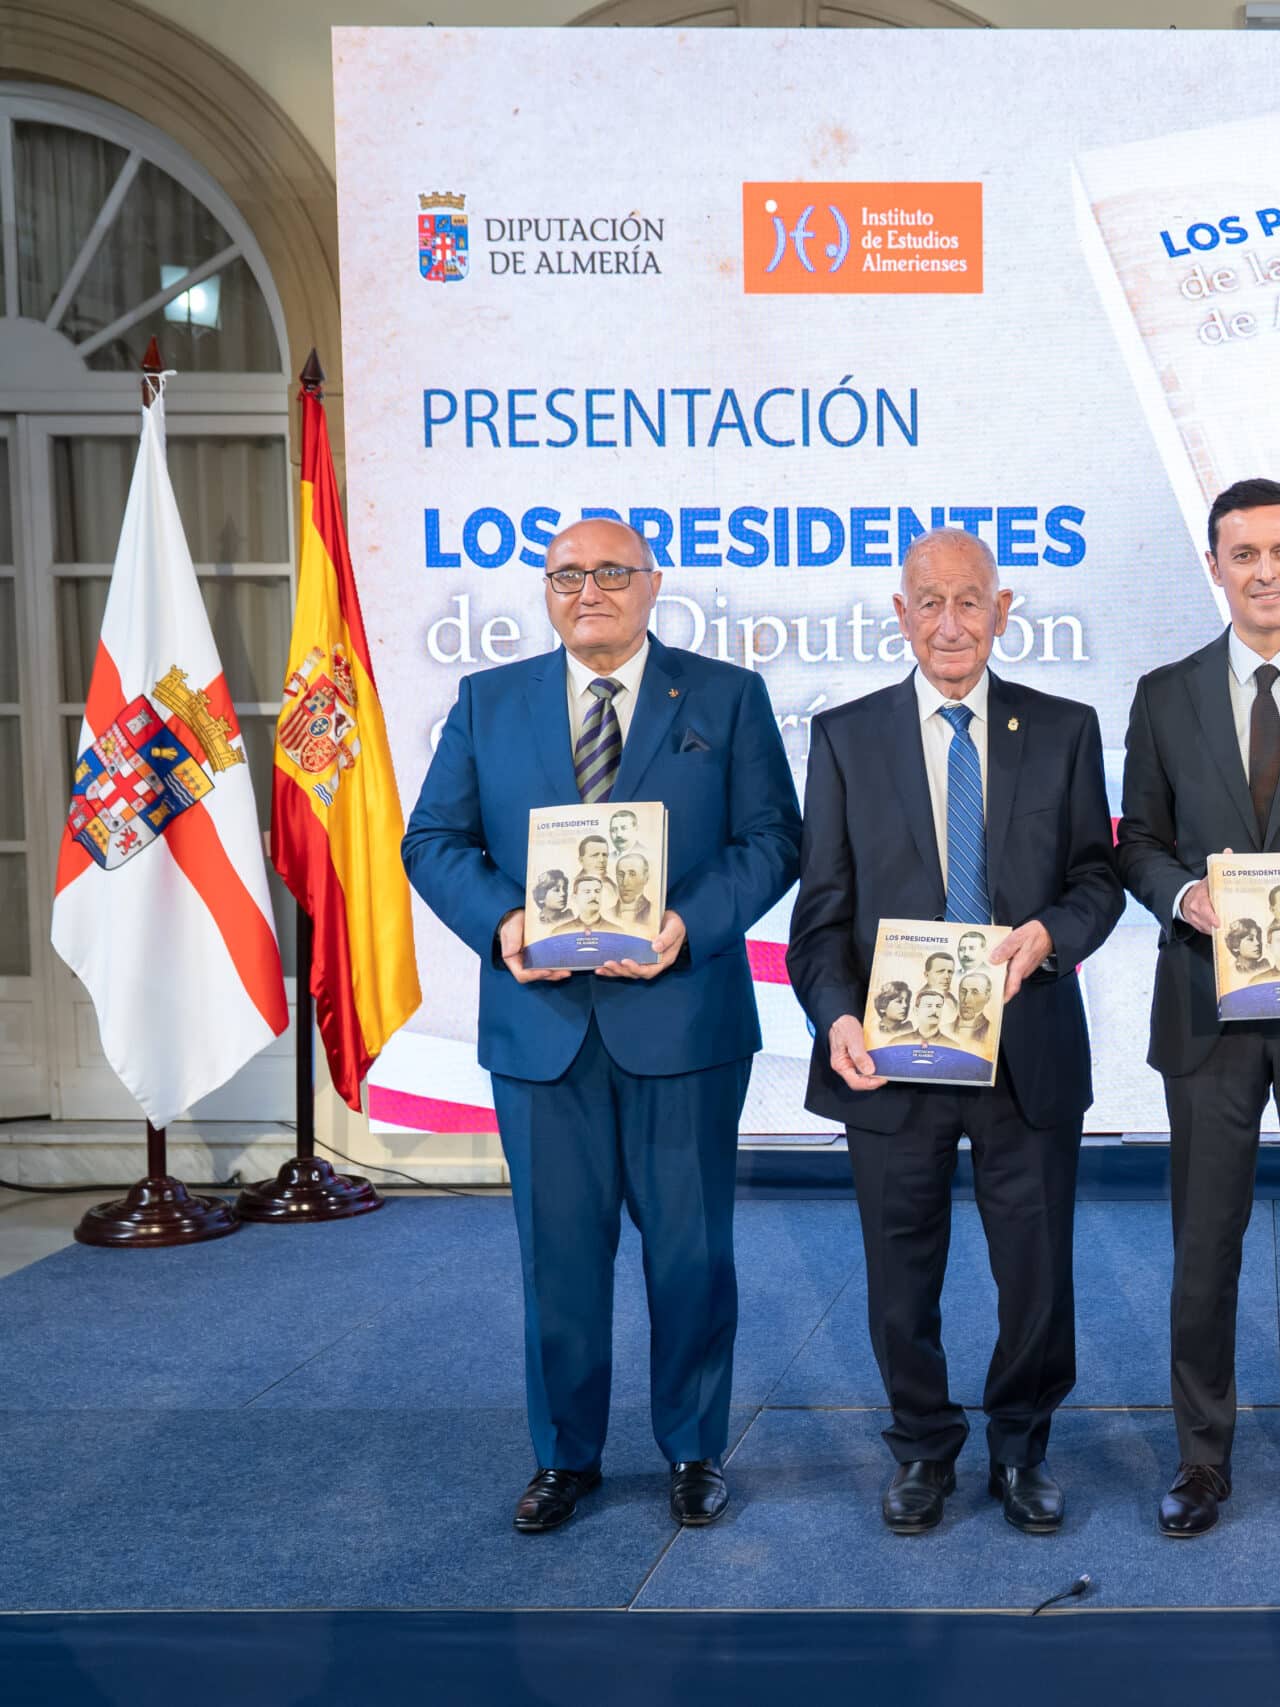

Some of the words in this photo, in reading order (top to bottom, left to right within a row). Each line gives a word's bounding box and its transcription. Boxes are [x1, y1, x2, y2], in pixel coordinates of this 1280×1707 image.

[485, 209, 665, 242] DIPUTACIÓN
[861, 207, 934, 226] Instituto
[861, 230, 882, 249] de
[887, 230, 960, 249] Estudios
[1160, 215, 1248, 258] LOS
[488, 251, 526, 274] DE
[534, 245, 663, 274] ALMERÍA
[862, 253, 968, 272] Almerienses
[1180, 264, 1240, 299] de
[1199, 307, 1256, 345] de
[423, 375, 918, 448] PRESENTACIÓN
[424, 506, 561, 569] LOS
[427, 593, 521, 664] de
[649, 594, 1090, 668] Diputaón
[551, 819, 600, 829] PRESIDENTES
[900, 935, 949, 943] PRESIDENTES
